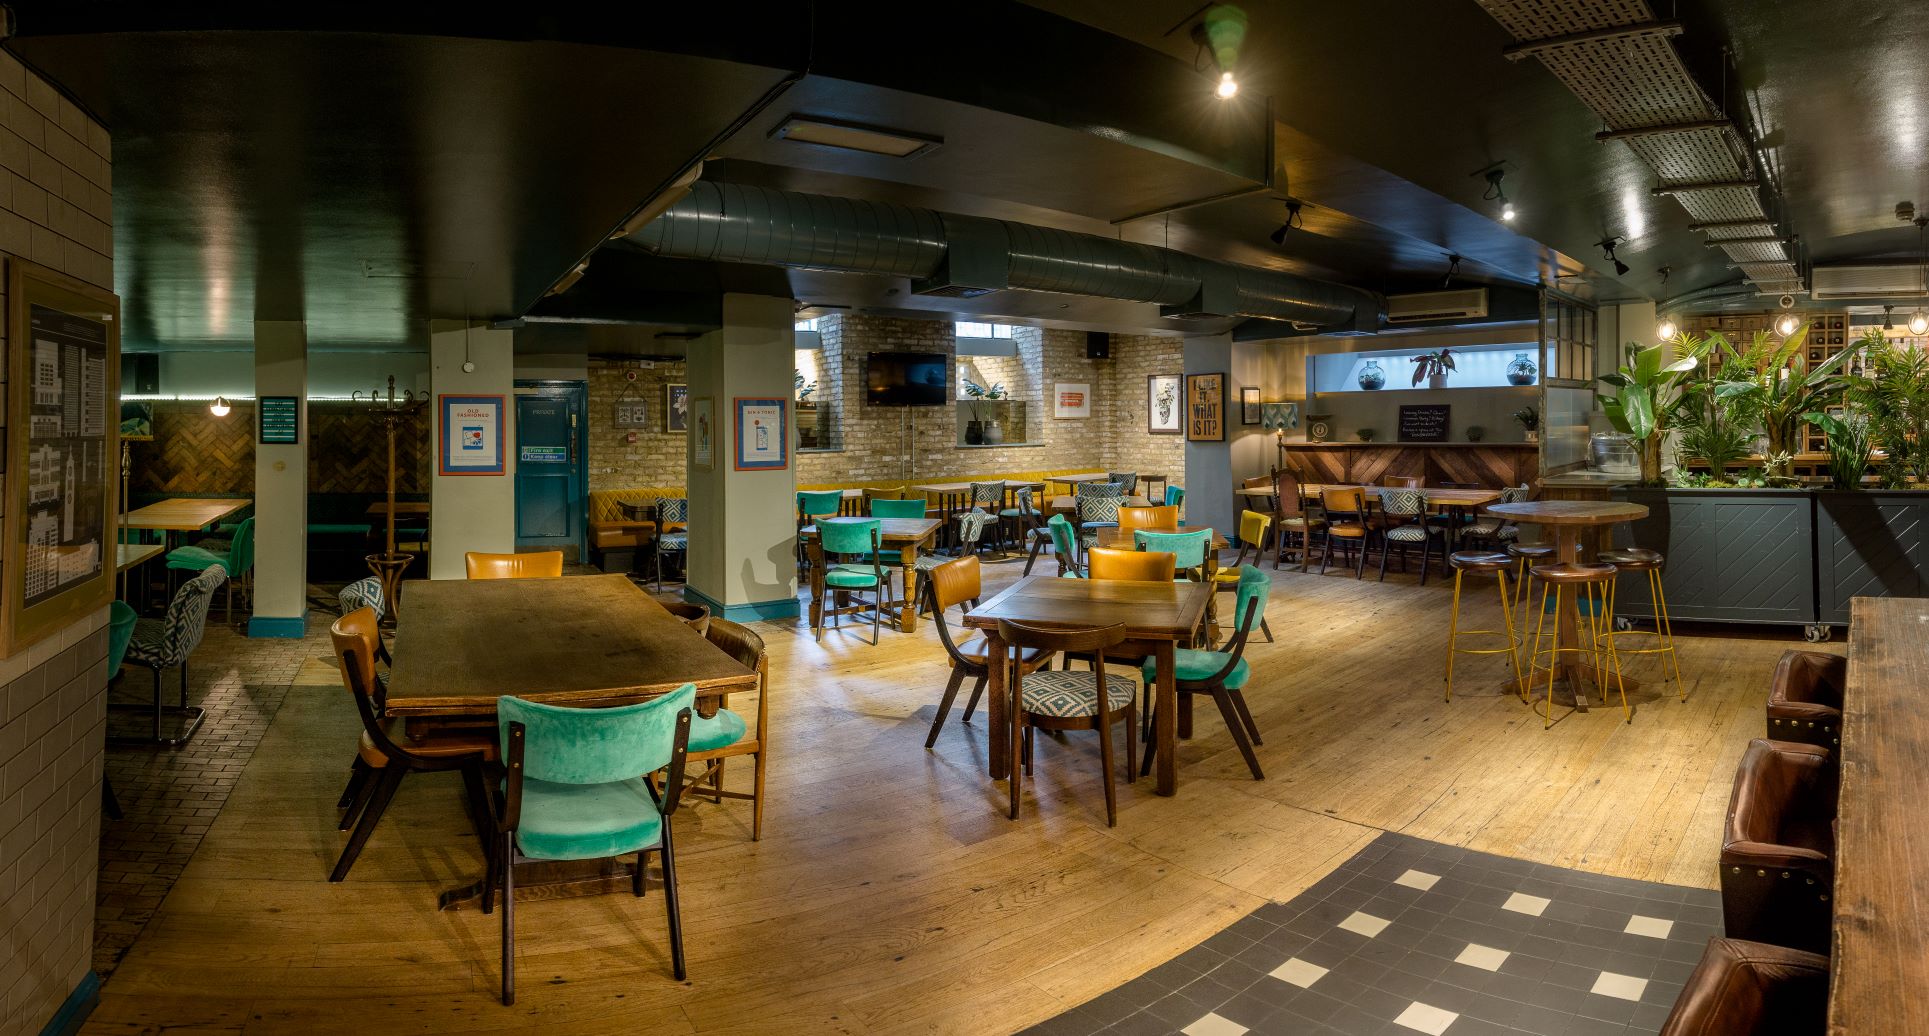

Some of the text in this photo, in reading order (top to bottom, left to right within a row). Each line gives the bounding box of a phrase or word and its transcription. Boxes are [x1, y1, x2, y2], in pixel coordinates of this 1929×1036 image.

[1193, 403, 1218, 419] WHAT
[1193, 419, 1217, 436] IS IT?
